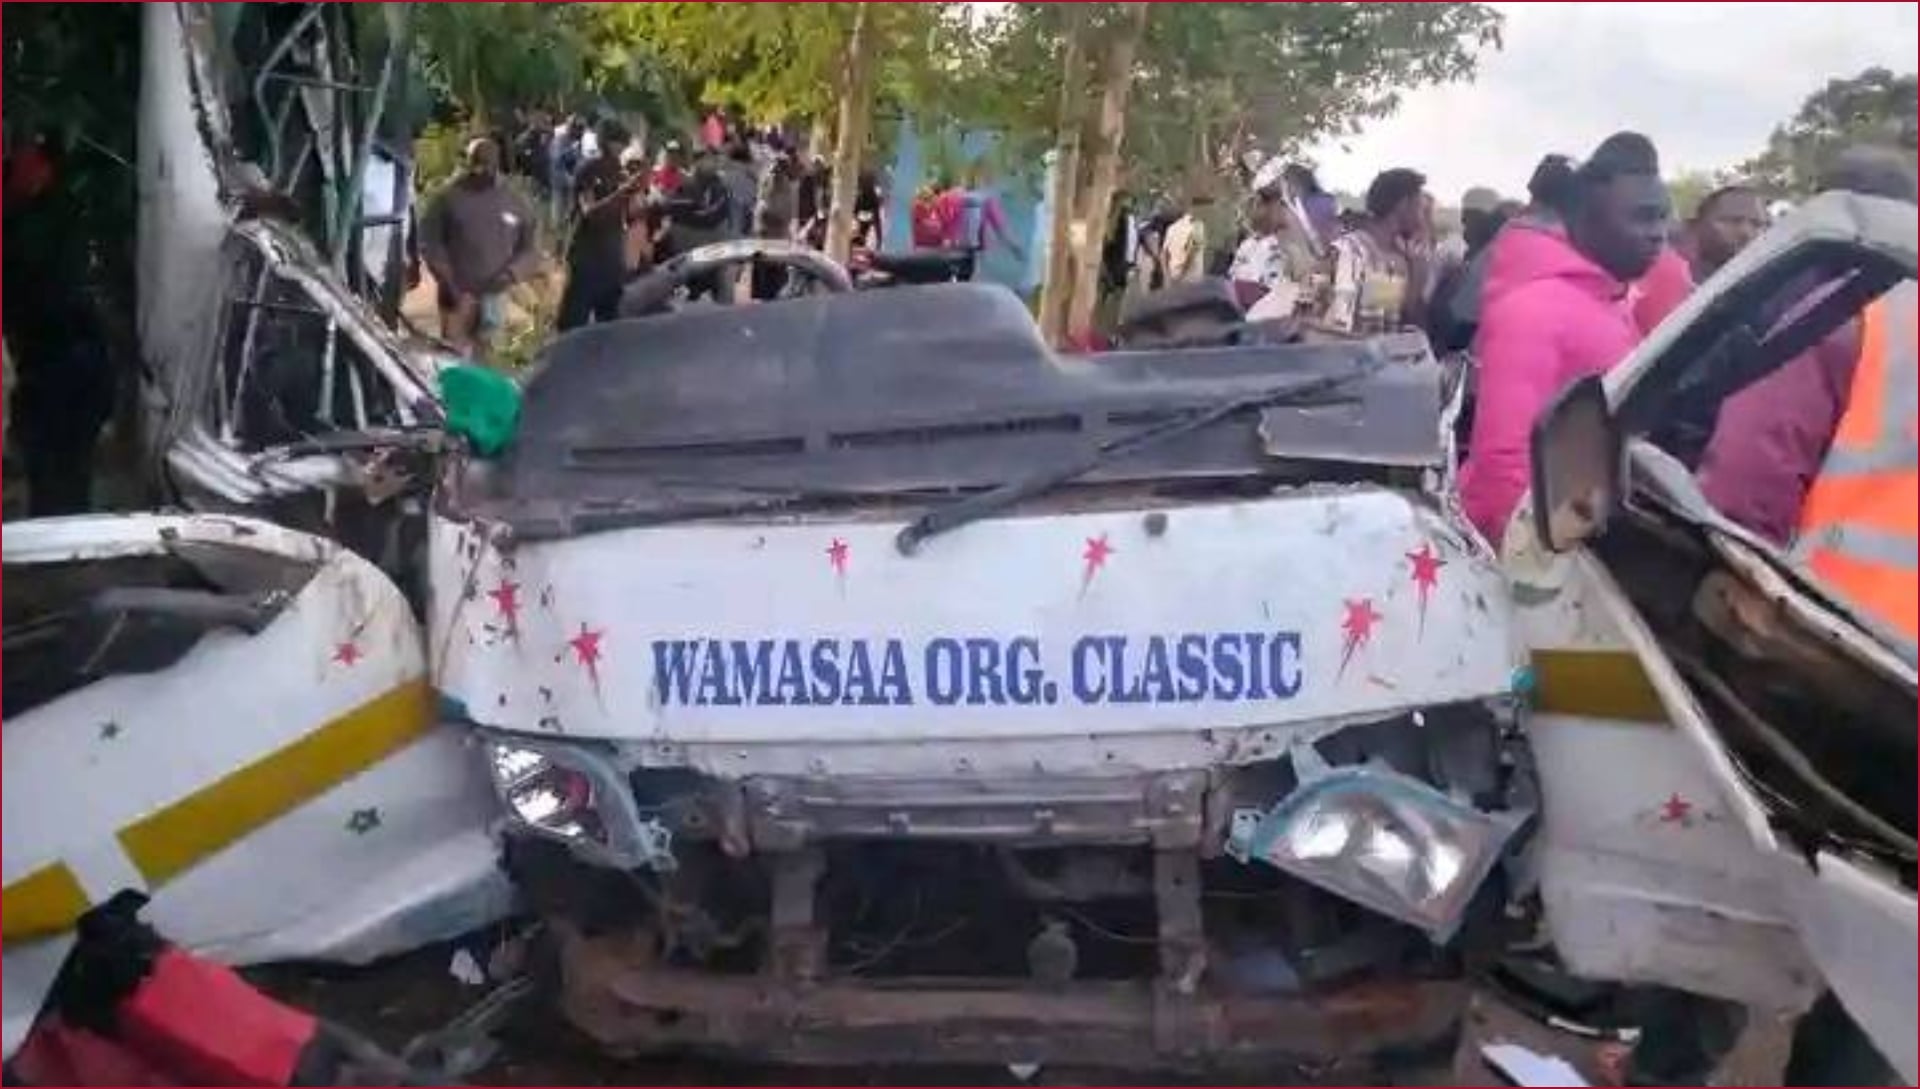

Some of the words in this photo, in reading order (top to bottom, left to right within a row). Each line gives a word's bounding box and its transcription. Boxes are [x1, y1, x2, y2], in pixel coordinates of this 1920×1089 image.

[651, 638, 914, 706] WAMASAA
[924, 637, 1058, 705] ORG.
[1071, 631, 1303, 703] CLASSIC
